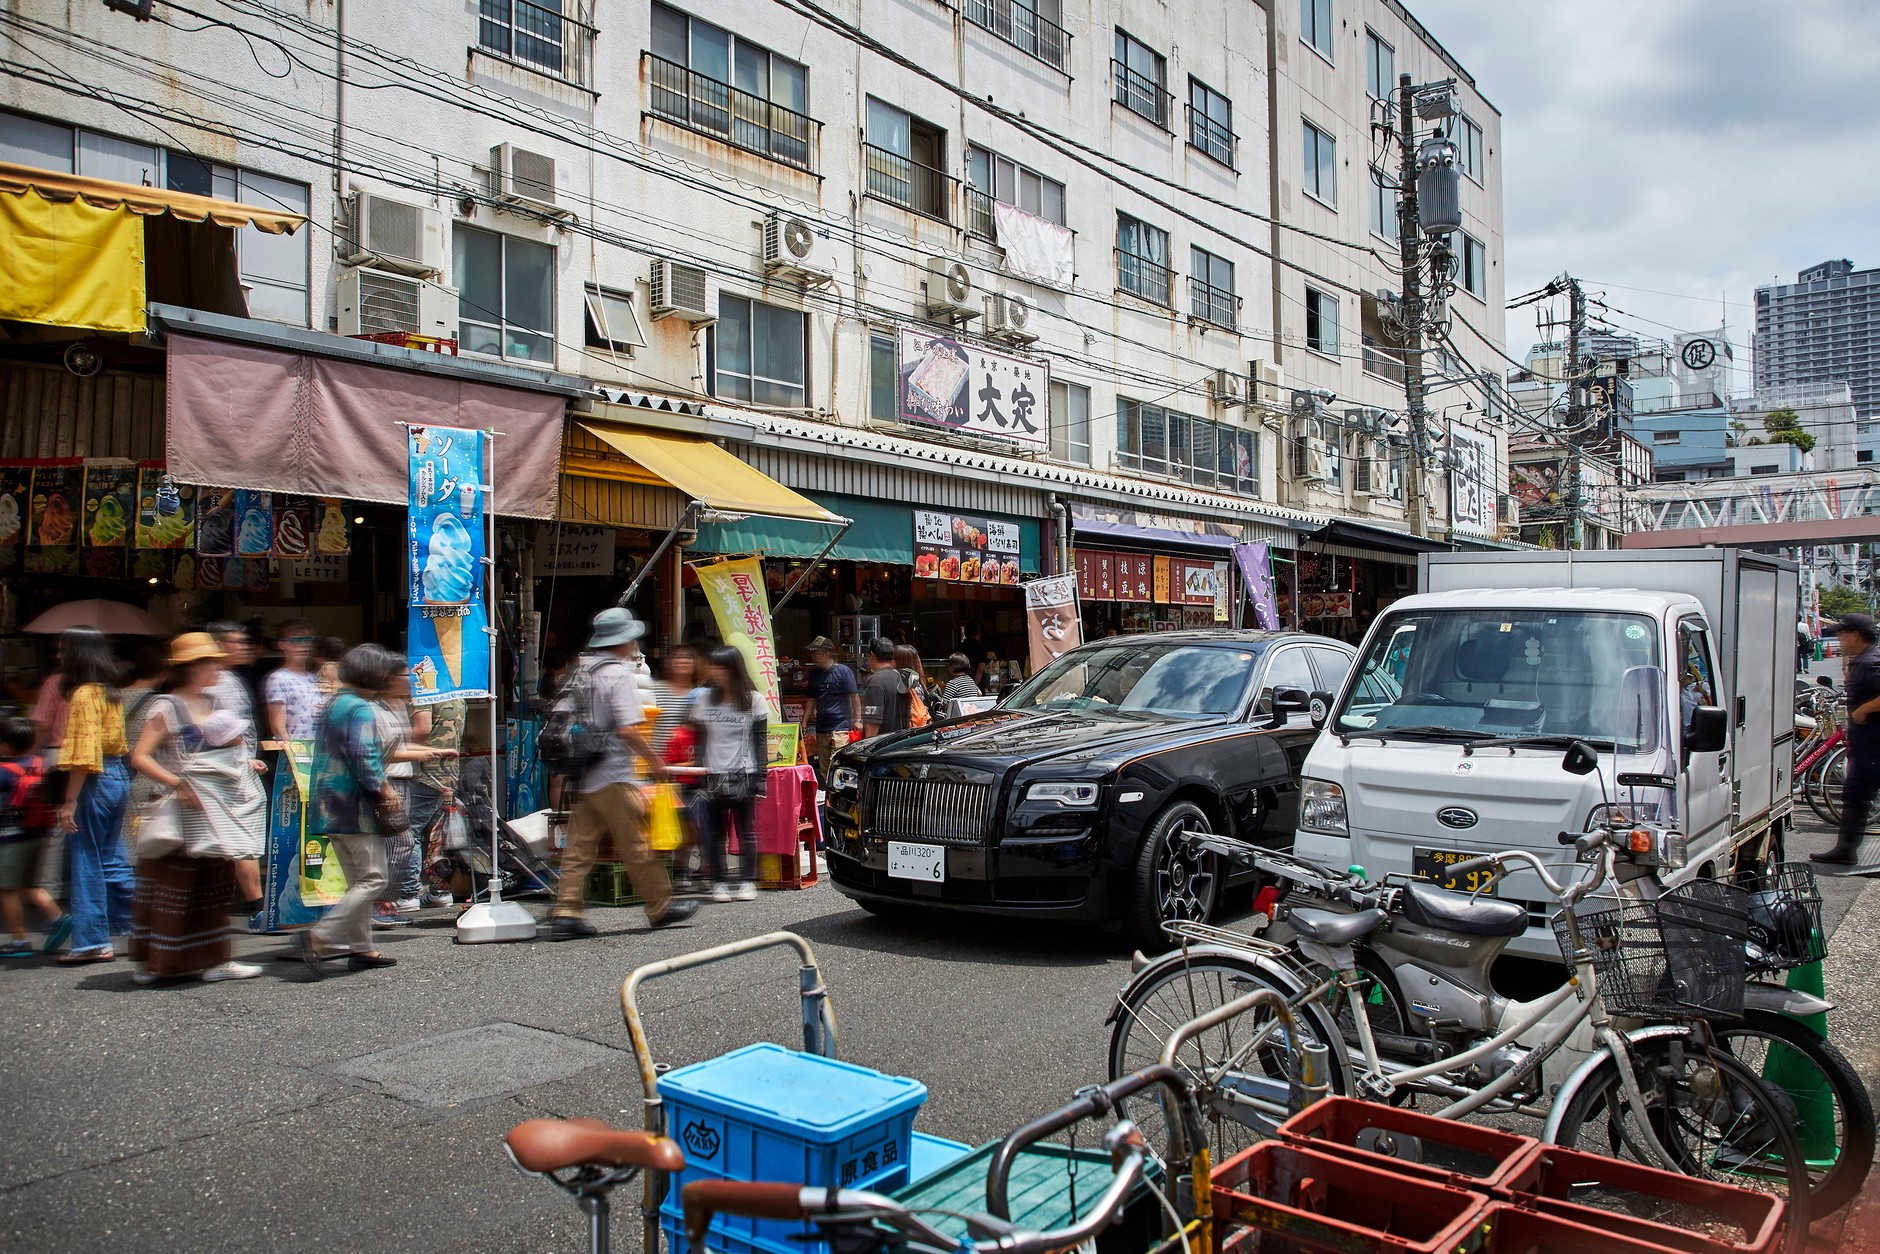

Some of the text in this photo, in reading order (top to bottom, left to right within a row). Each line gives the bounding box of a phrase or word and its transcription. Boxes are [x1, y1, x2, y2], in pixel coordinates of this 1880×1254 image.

[1688, 343, 1707, 365] 促
[979, 357, 1032, 380] 東京・築地
[976, 372, 1039, 434] 大定
[436, 436, 459, 502] ソーダ
[989, 524, 1005, 536] 海鮮
[989, 538, 1018, 550] いなり寿司
[1120, 560, 1129, 594] 枝豆
[865, 705, 877, 715] 37
[1424, 933, 1471, 948] Super Cub
[1413, 1000, 1439, 1010] HONDA
[687, 1132, 717, 1152] HARA
[841, 1140, 898, 1184] 原食品
